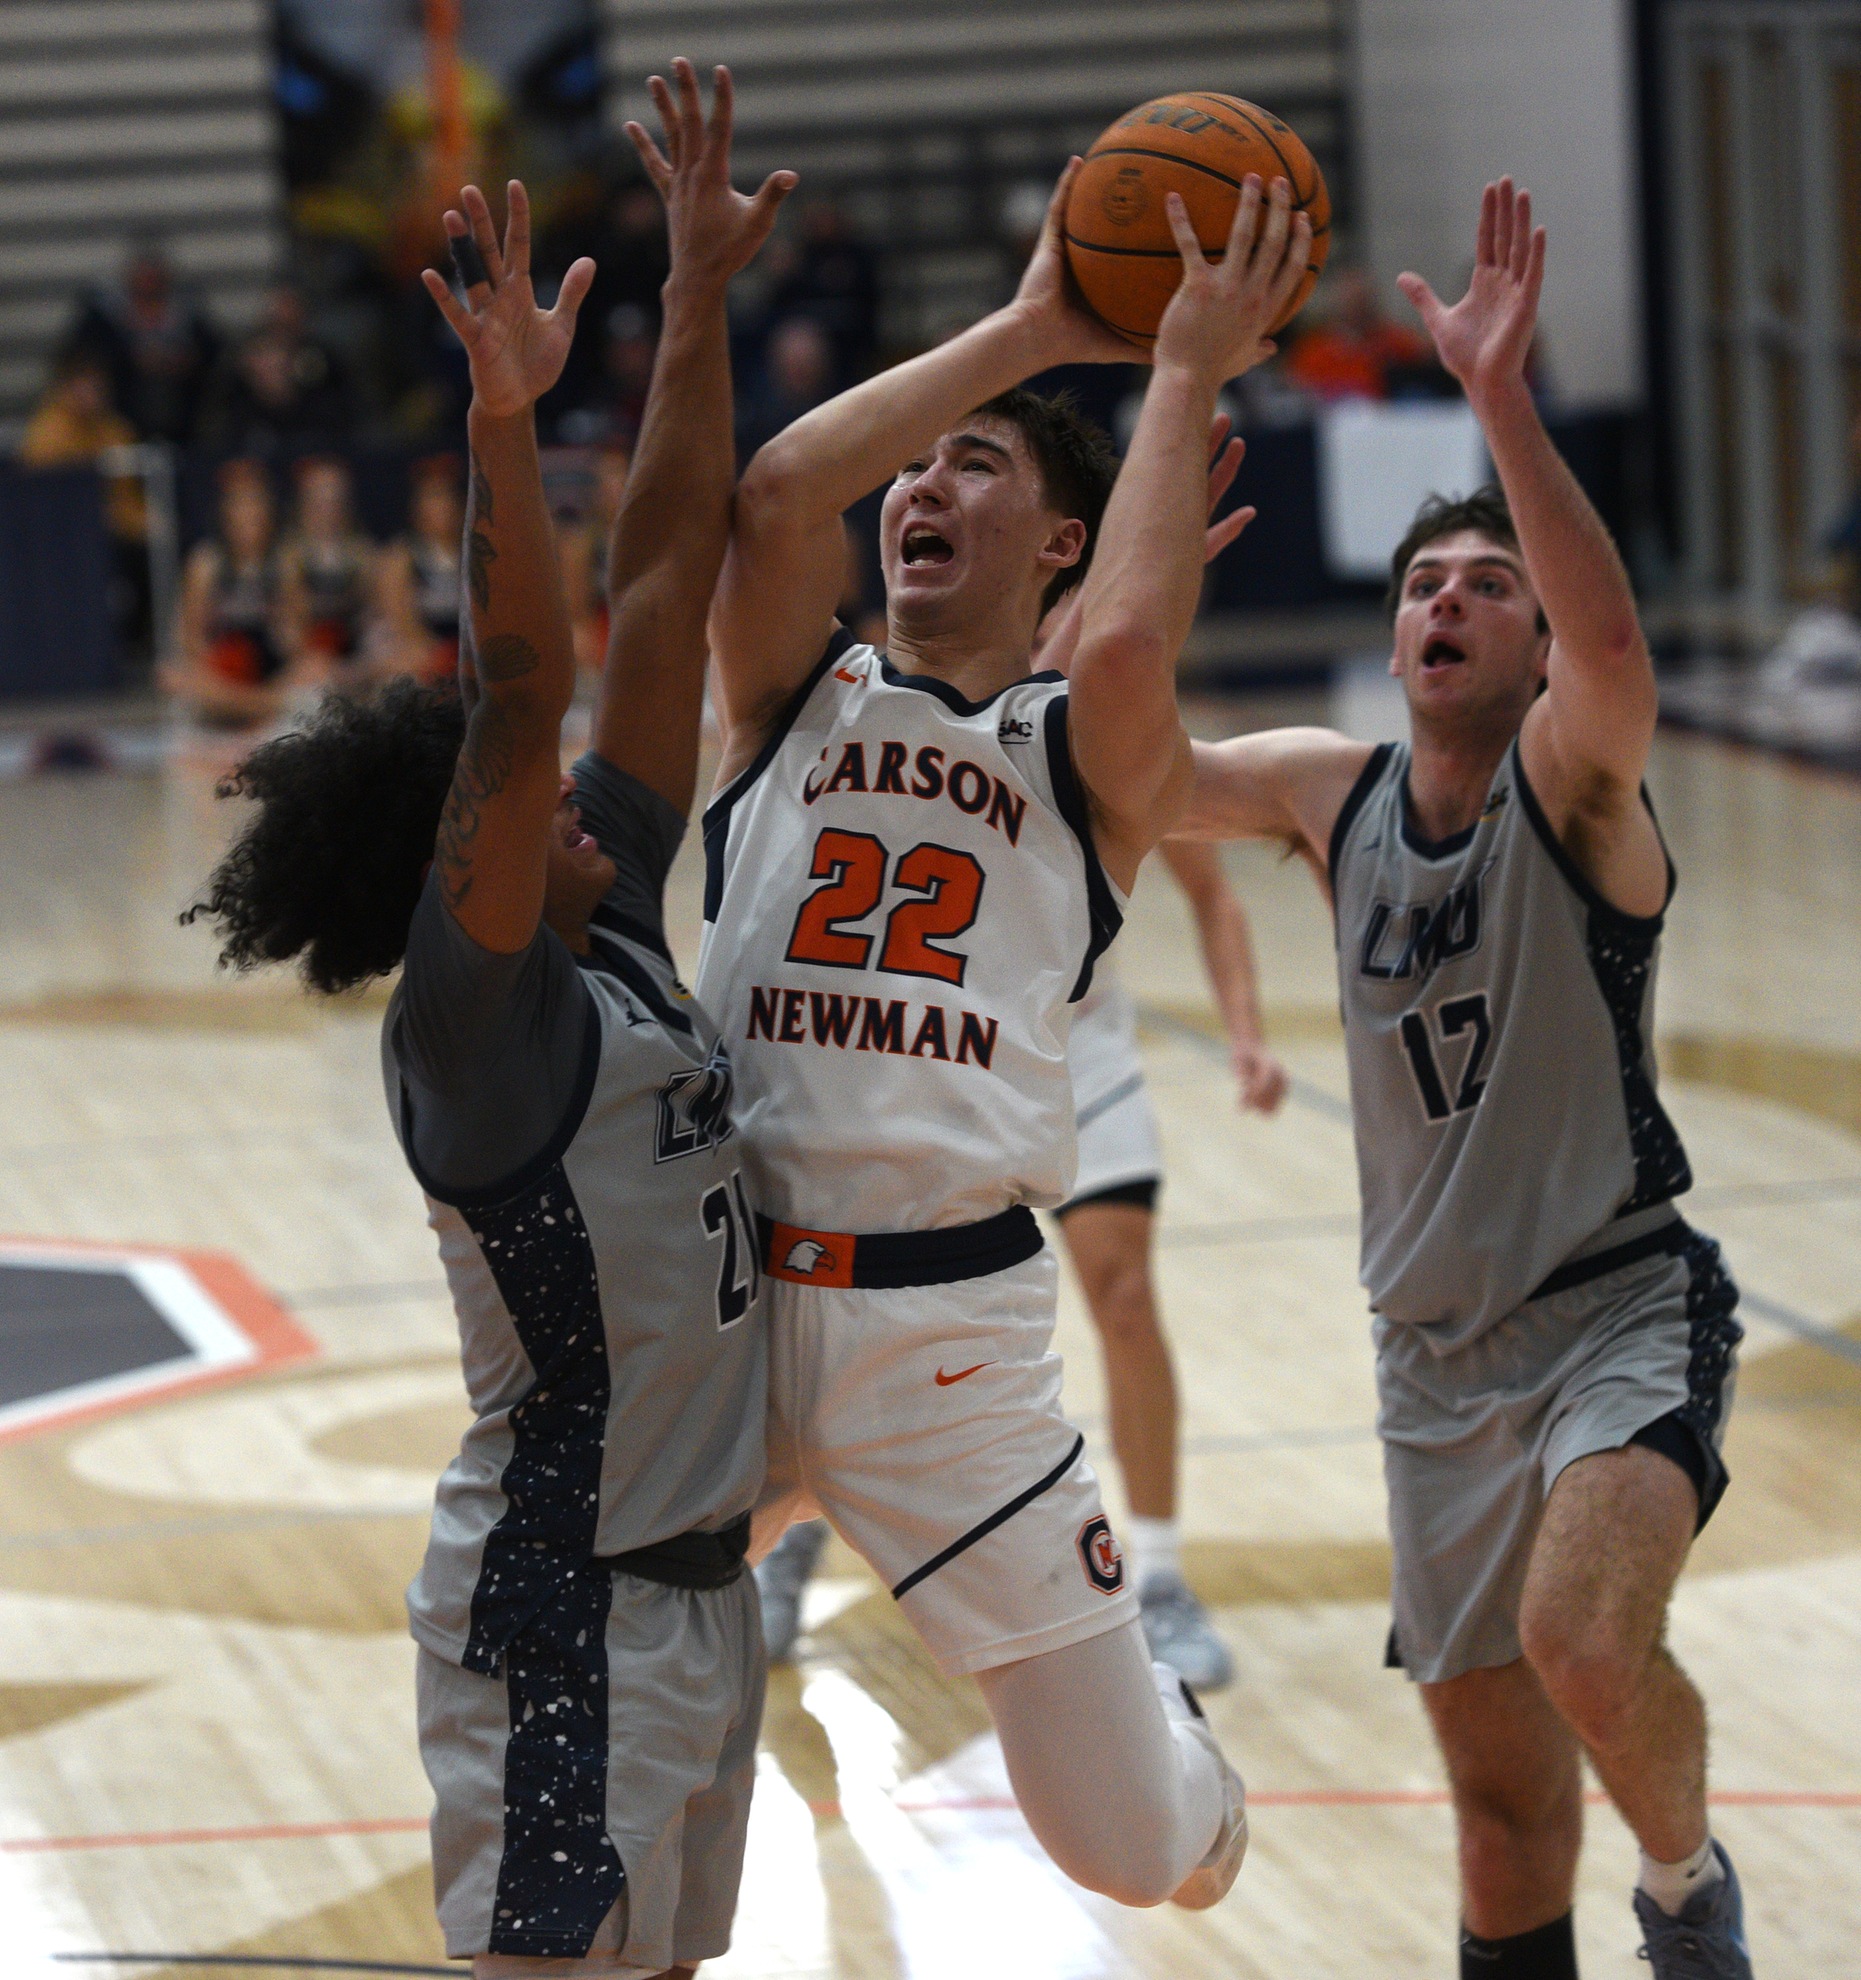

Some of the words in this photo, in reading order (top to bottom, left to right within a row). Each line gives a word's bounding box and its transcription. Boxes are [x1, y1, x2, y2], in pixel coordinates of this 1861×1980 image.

[784, 827, 986, 988] 22
[746, 986, 999, 1070] NEWMAN
[1398, 993, 1490, 1126] 12
